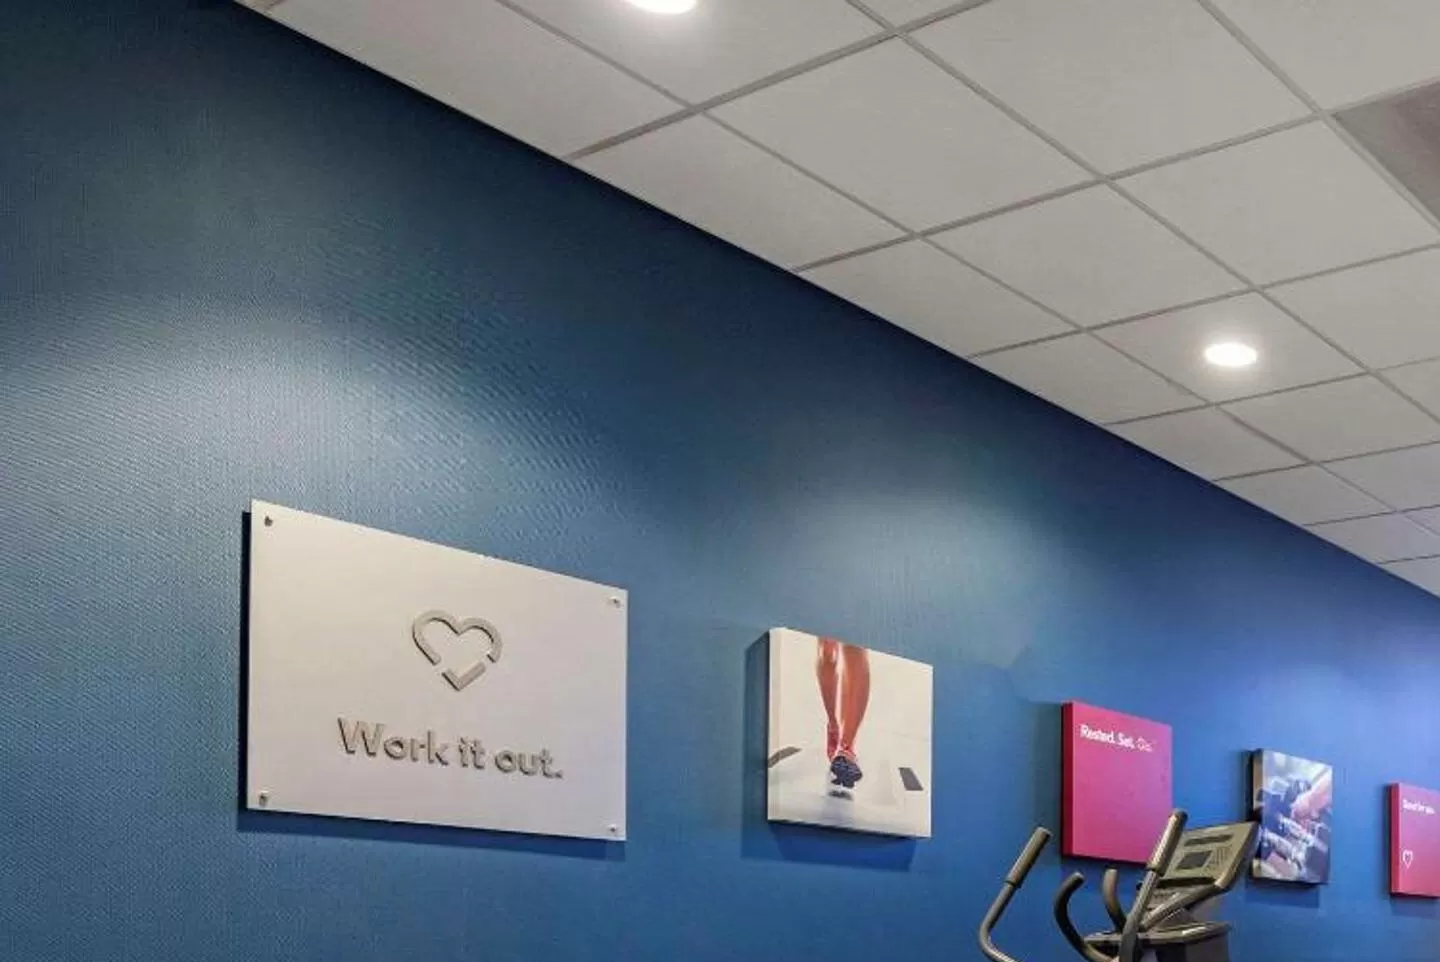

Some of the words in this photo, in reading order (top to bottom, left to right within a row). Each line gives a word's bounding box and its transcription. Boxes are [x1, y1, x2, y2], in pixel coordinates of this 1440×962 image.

[337, 717, 449, 766] Work
[458, 736, 485, 770] it
[495, 748, 563, 779] out.
